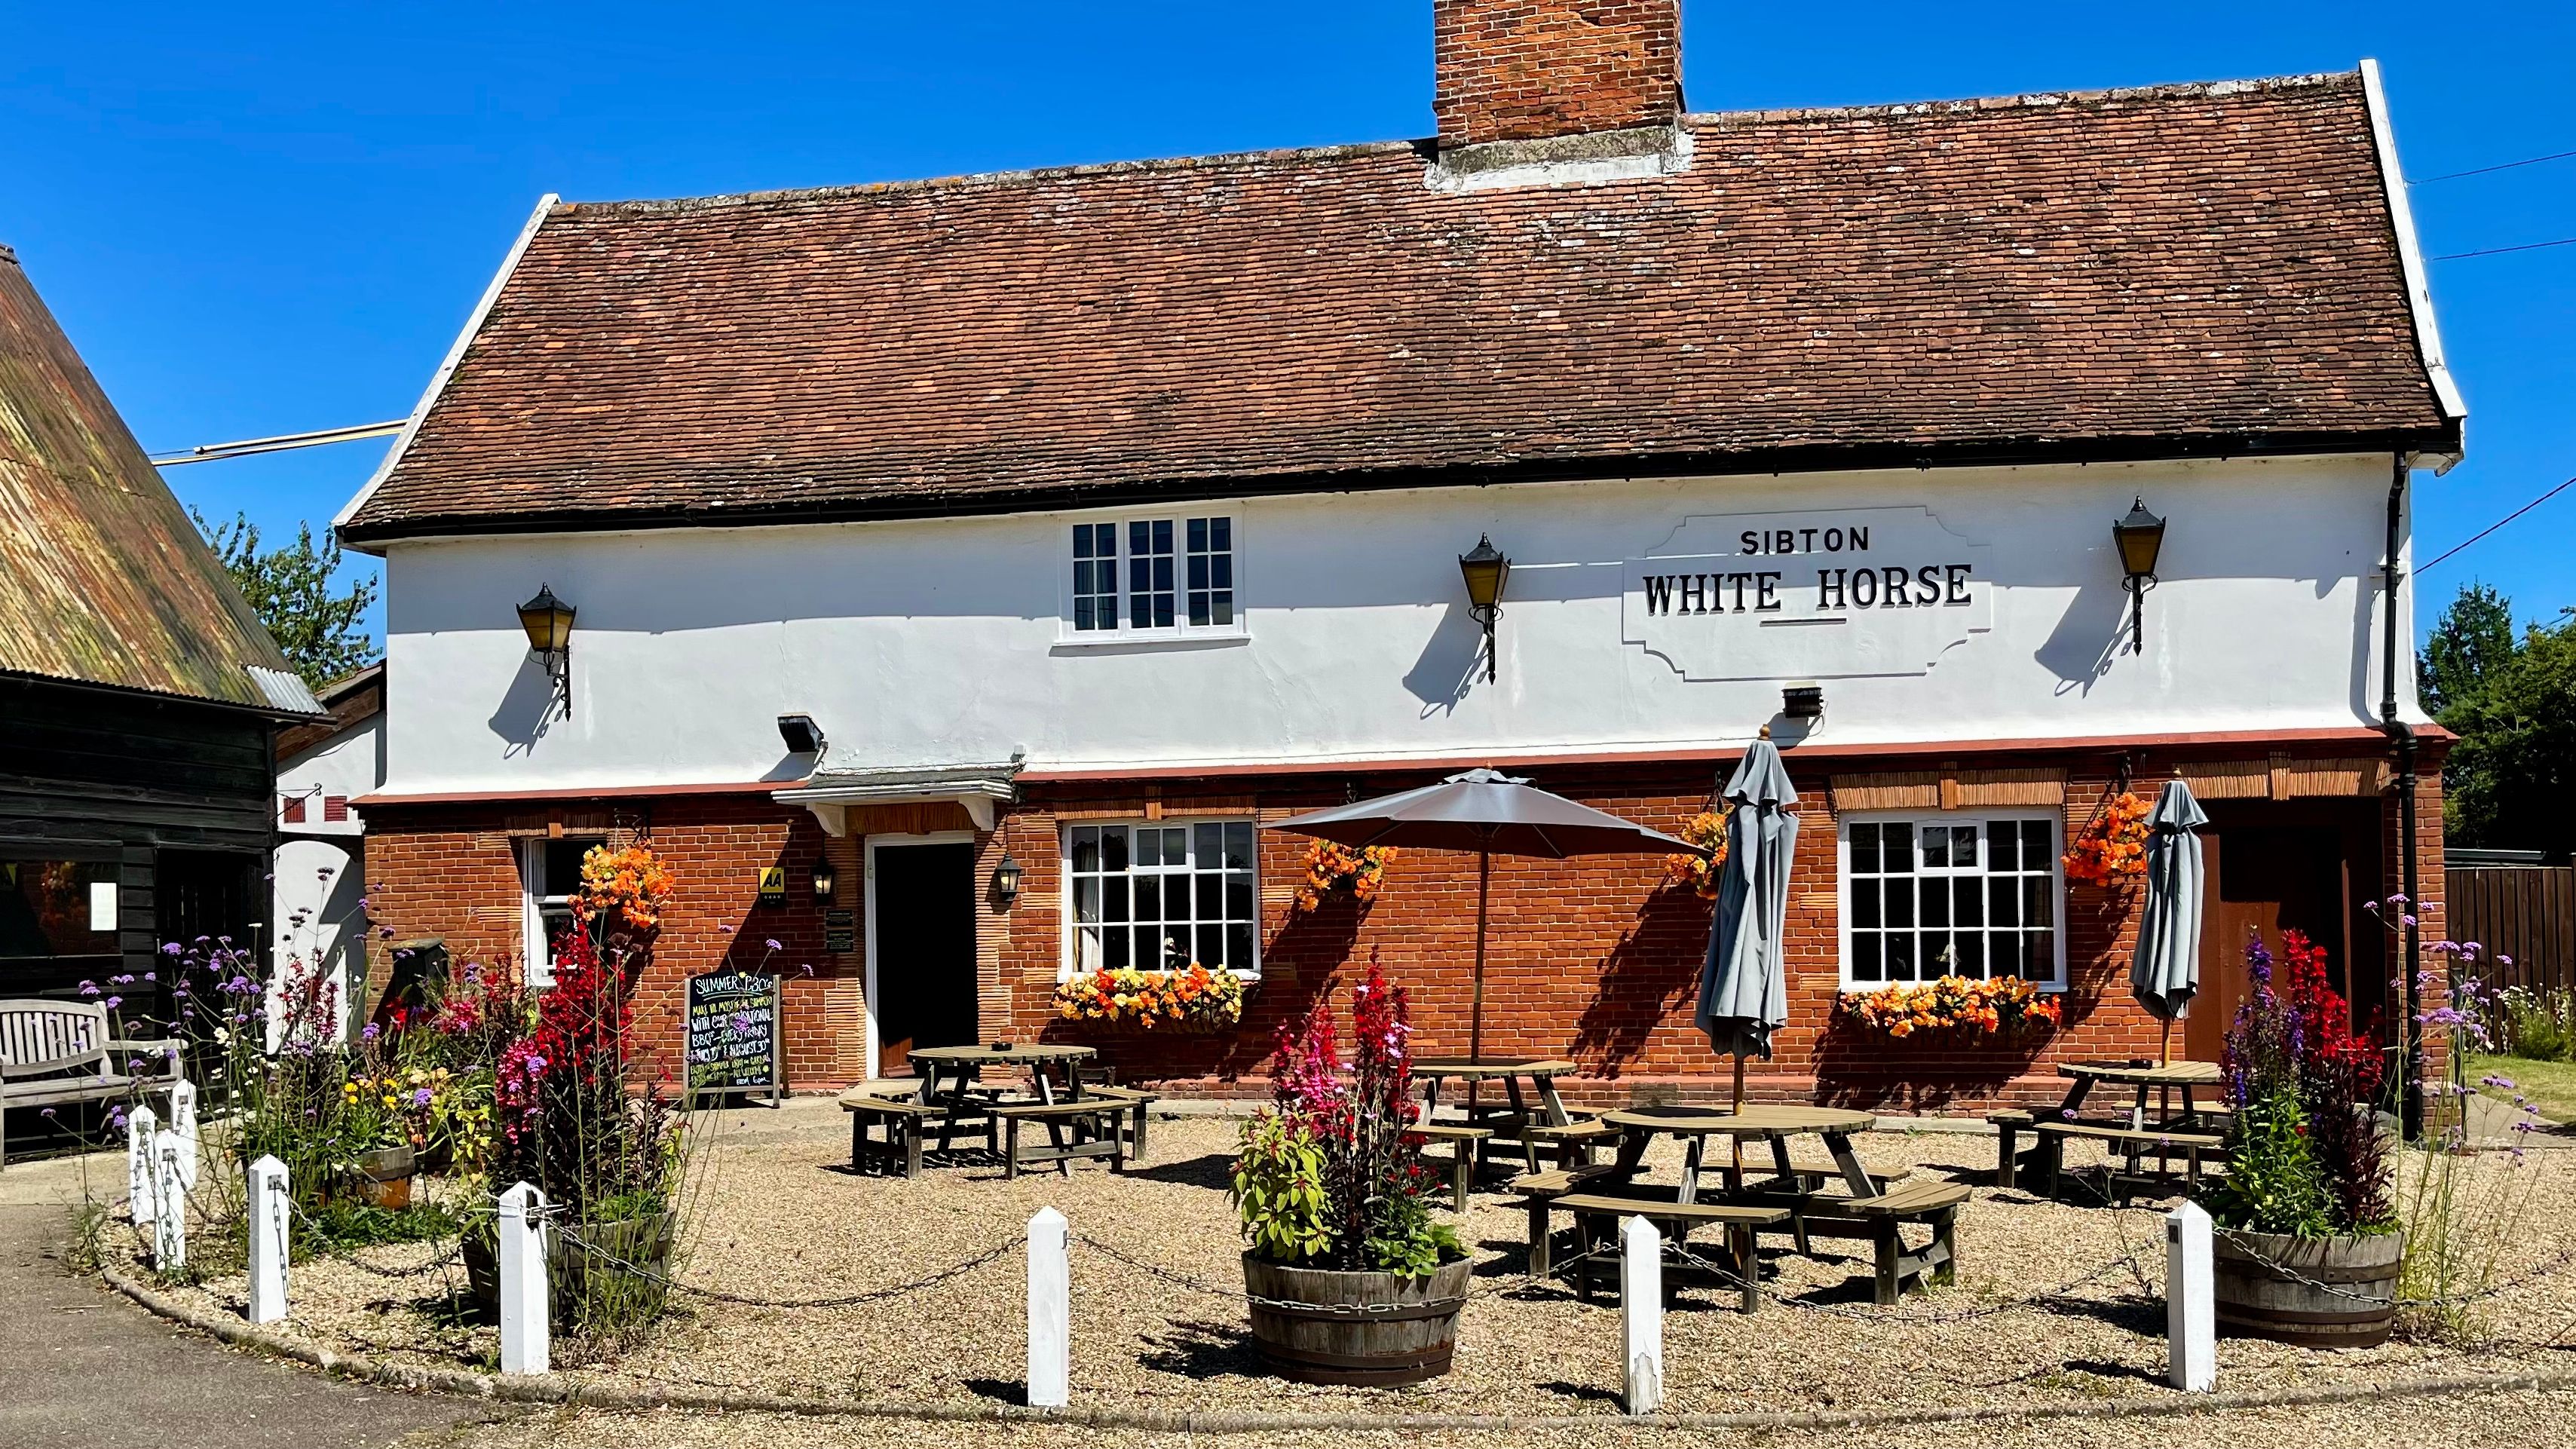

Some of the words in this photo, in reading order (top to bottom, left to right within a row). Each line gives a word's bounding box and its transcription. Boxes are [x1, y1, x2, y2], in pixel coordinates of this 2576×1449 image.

[1741, 526, 1869, 555] SIBTON
[1643, 571, 1781, 615] WHITE
[1817, 564, 1972, 611] HORSE
[763, 872, 782, 887] AA
[696, 976, 739, 994] SUMMER
[691, 1017, 710, 1031] WITH
